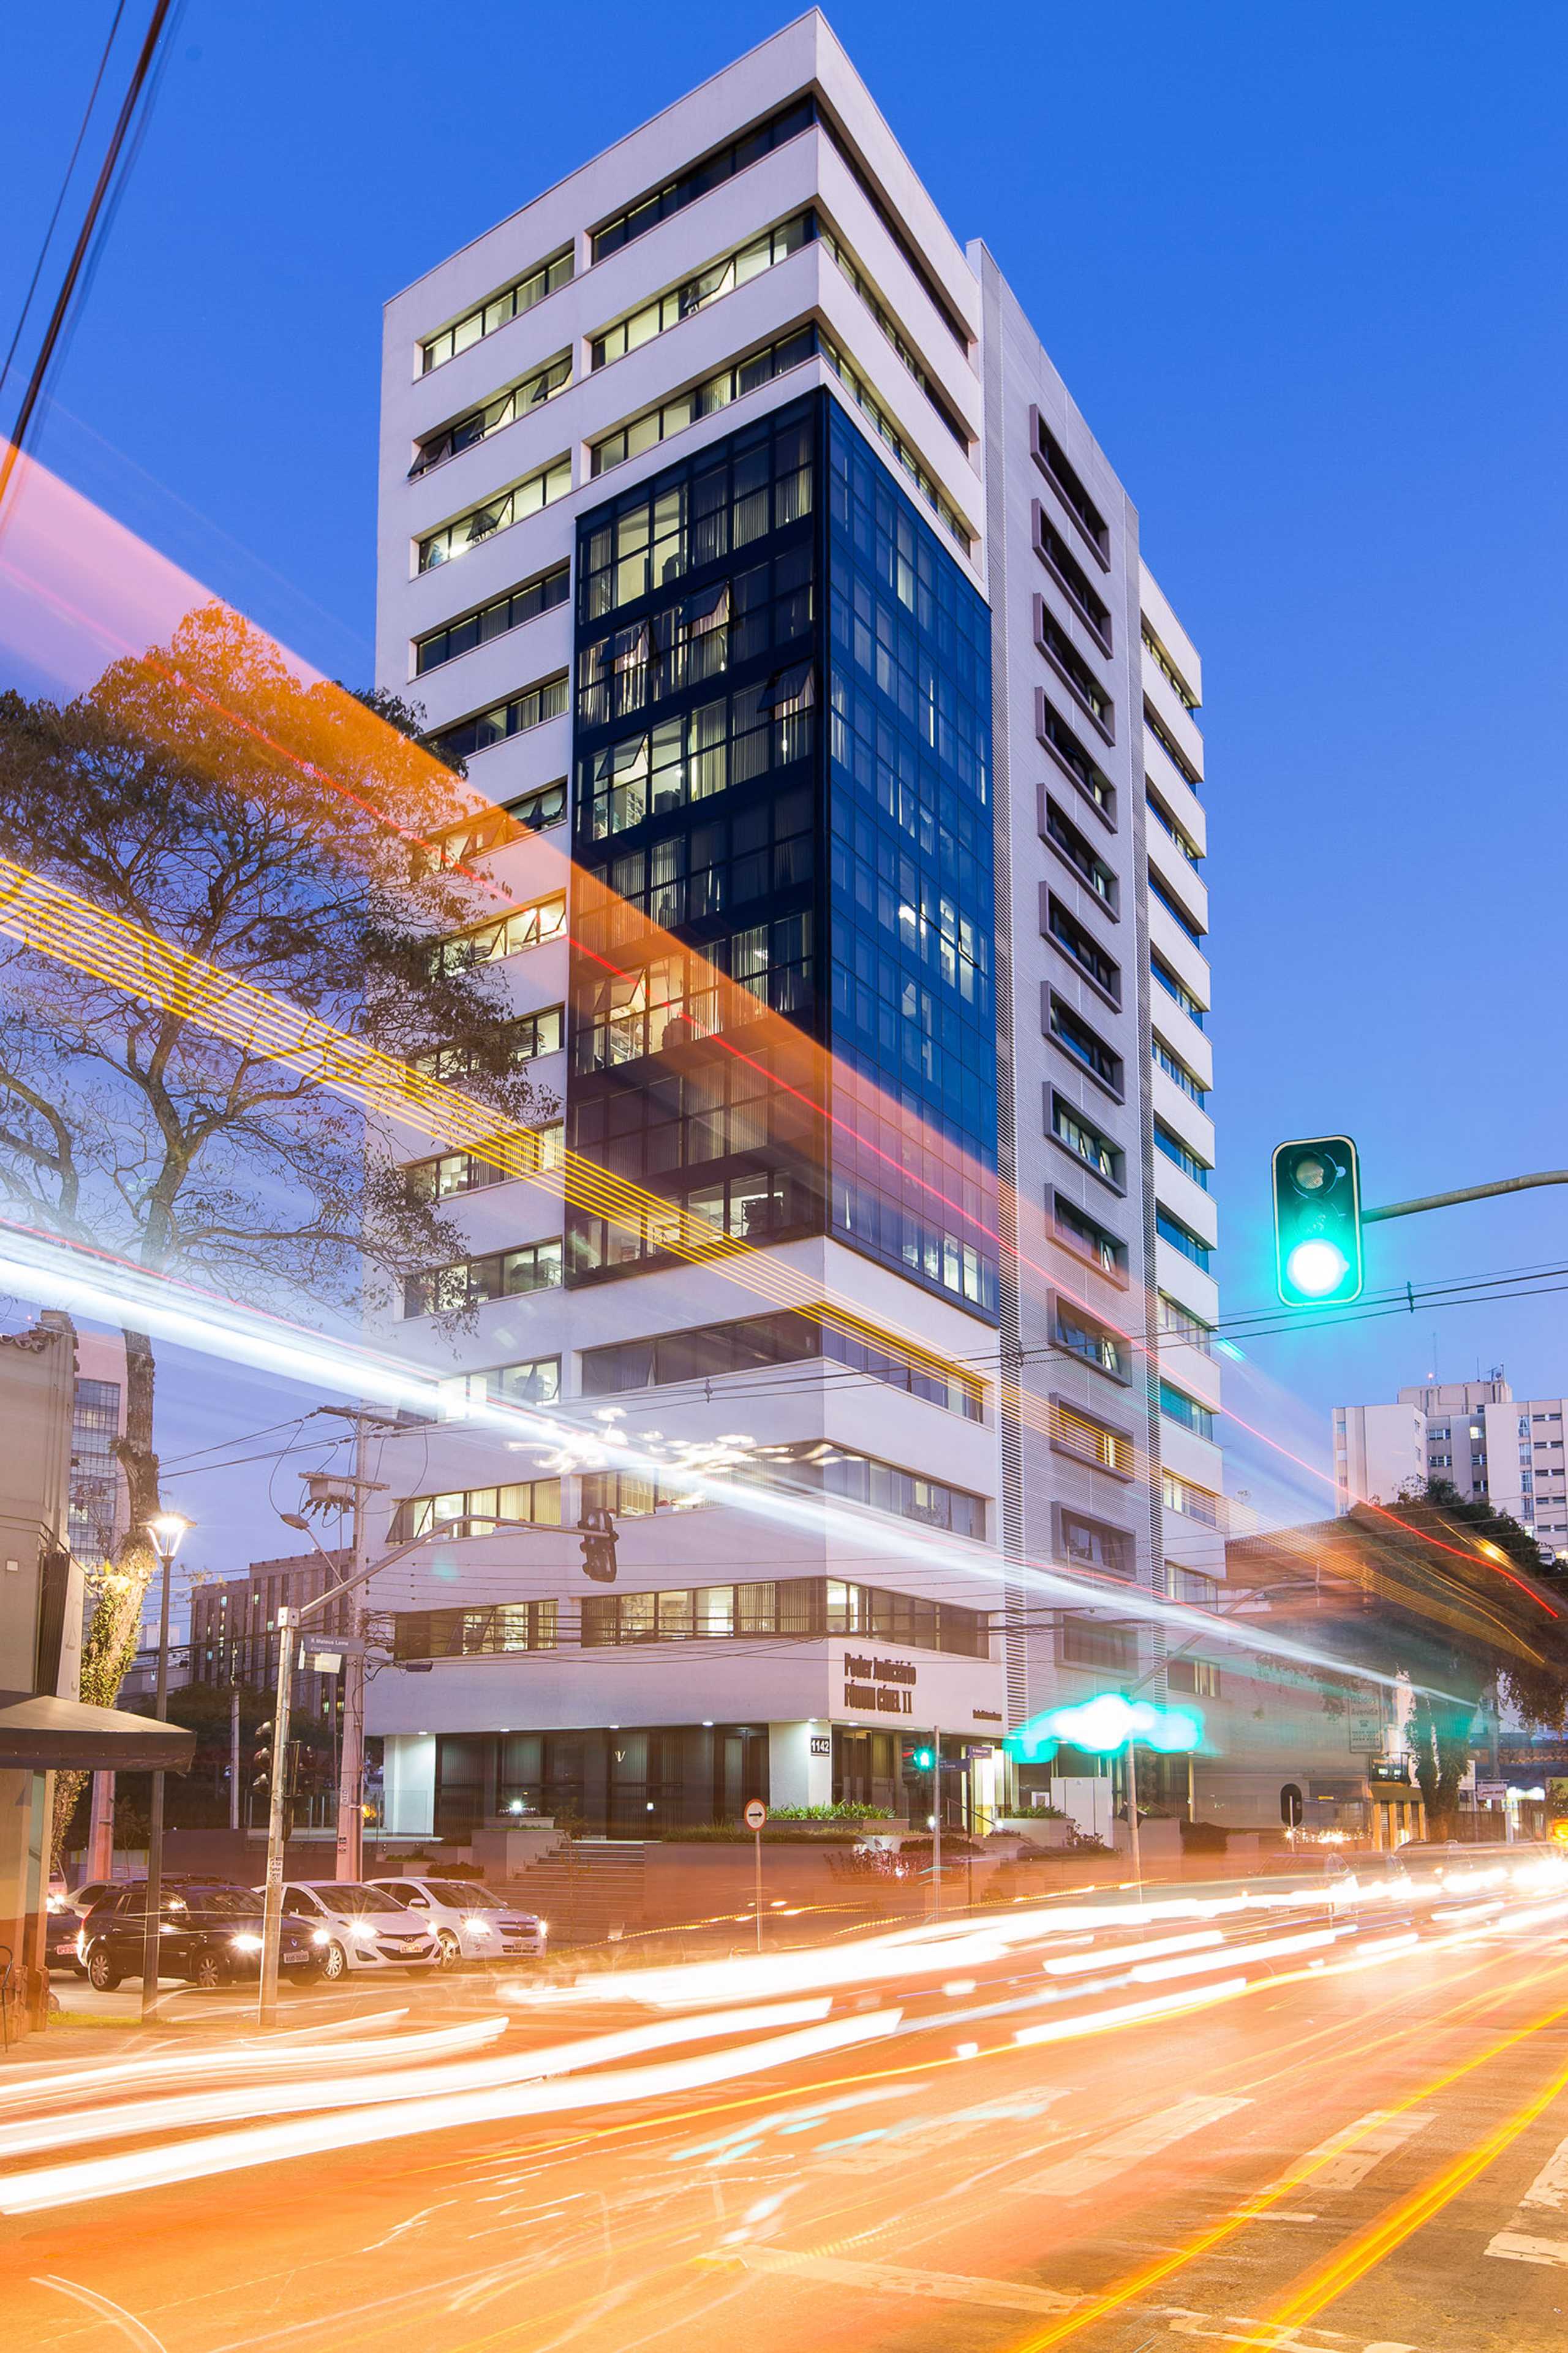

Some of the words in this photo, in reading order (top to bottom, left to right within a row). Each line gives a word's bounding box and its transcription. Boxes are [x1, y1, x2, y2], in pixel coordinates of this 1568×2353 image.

[844, 1652, 872, 1679] Poder
[873, 1656, 916, 1685] Judiciário
[902, 1690, 912, 1713] II
[811, 1739, 829, 1752] 1142
